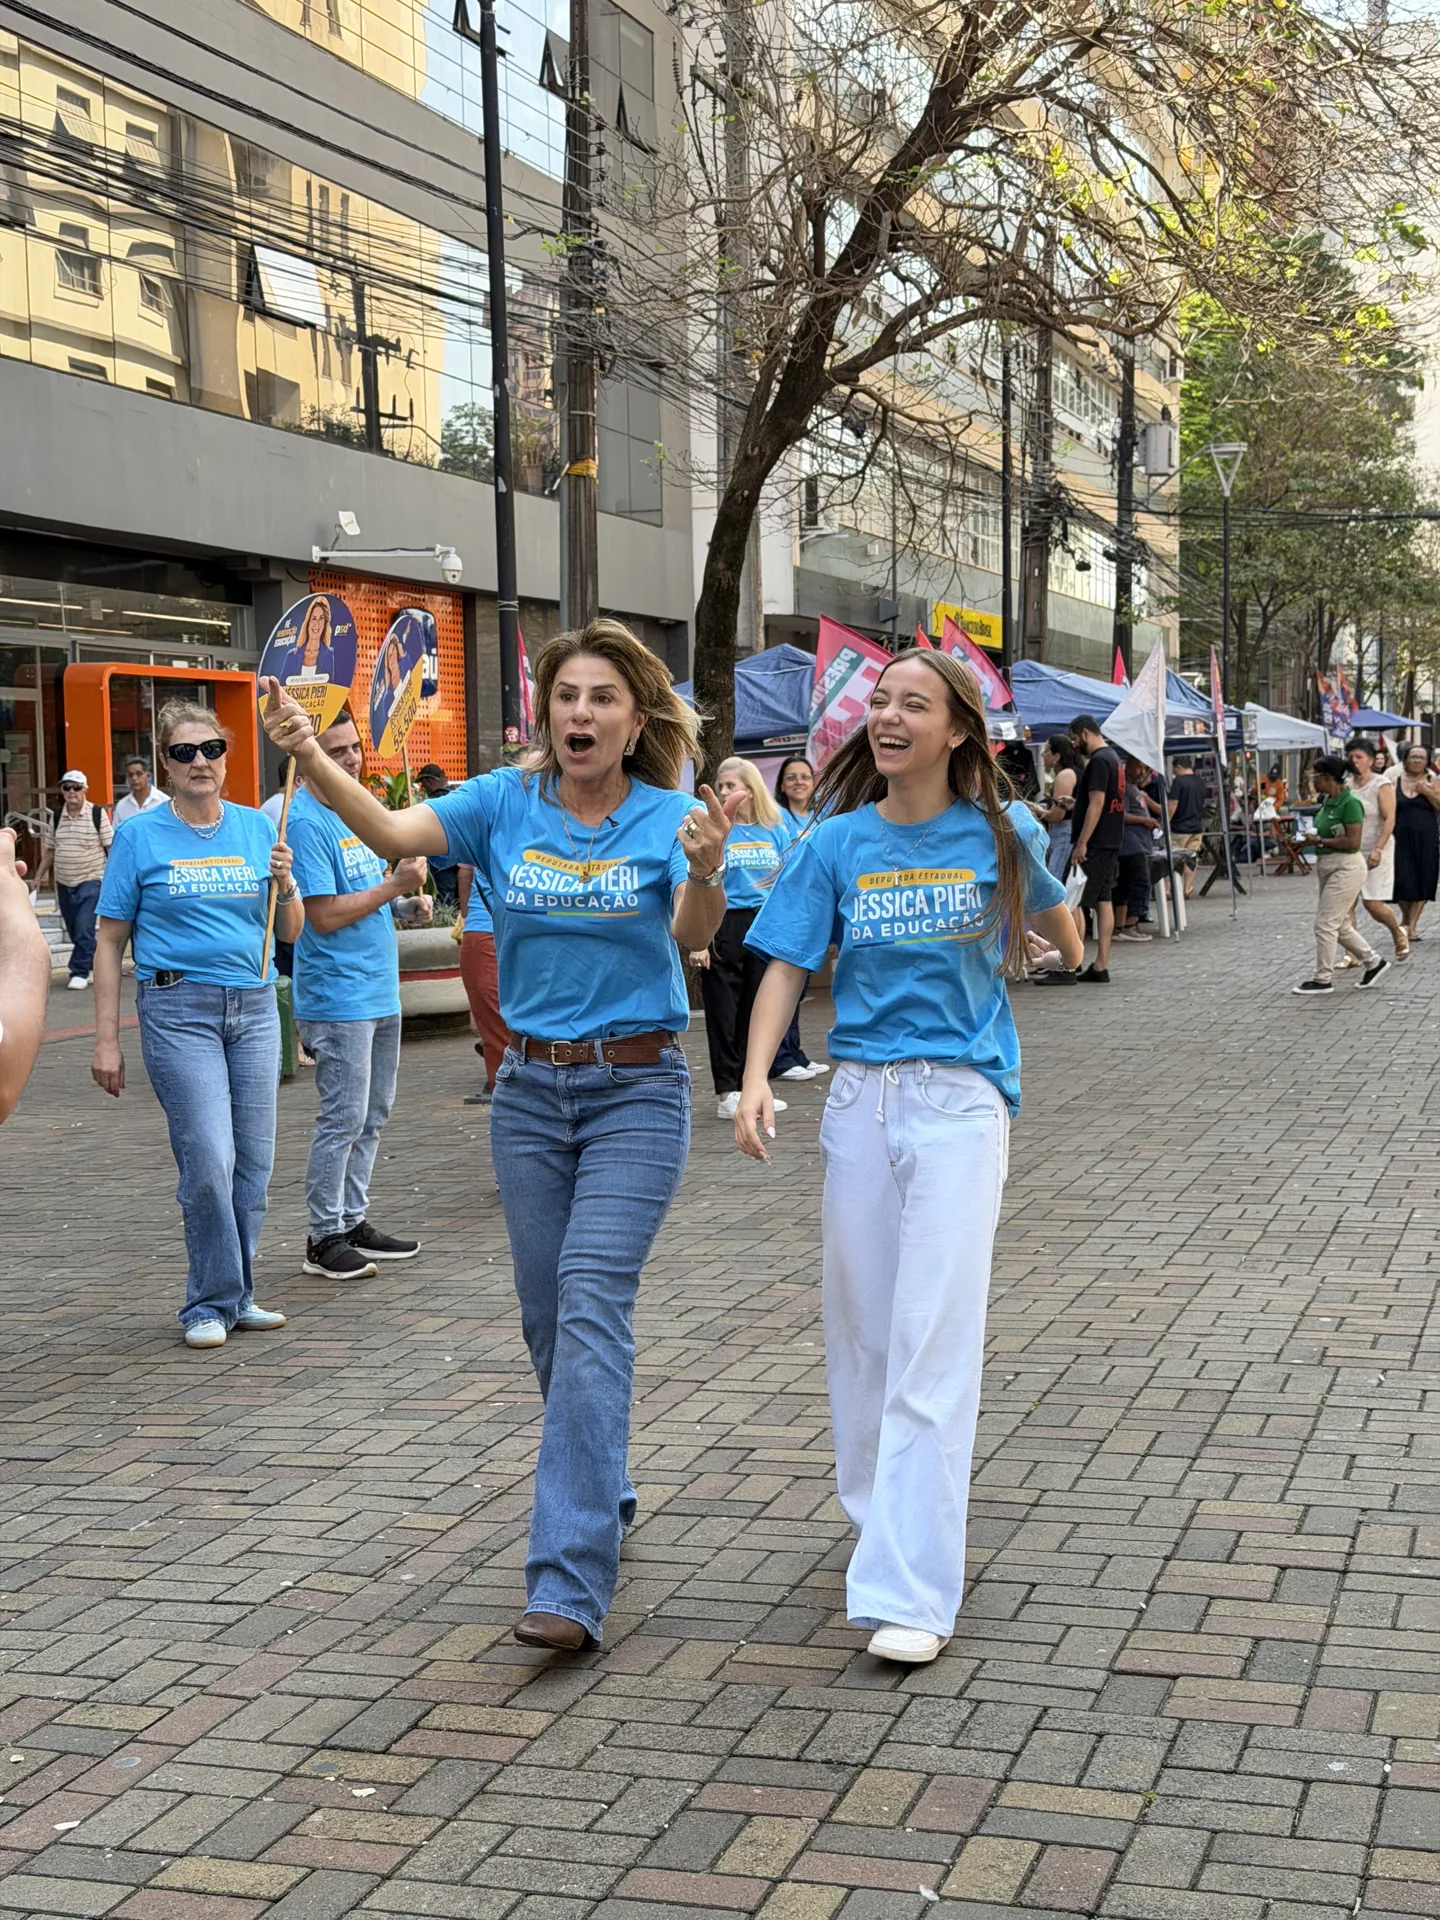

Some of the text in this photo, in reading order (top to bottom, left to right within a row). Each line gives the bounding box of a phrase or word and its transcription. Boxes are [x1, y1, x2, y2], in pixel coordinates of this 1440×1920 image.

[311, 684, 328, 699] PIERI
[535, 854, 580, 871] DEPUTADA
[728, 860, 739, 868] DA
[168, 865, 258, 885] JÉSSICA PIERI
[918, 872, 964, 880] ESTADUAL
[169, 881, 259, 895] DA EDUCAÇÃO
[505, 889, 639, 911] DA EDUCAÇÃO
[850, 884, 983, 923] JÉSSICA PIERI
[852, 925, 873, 940] DA
